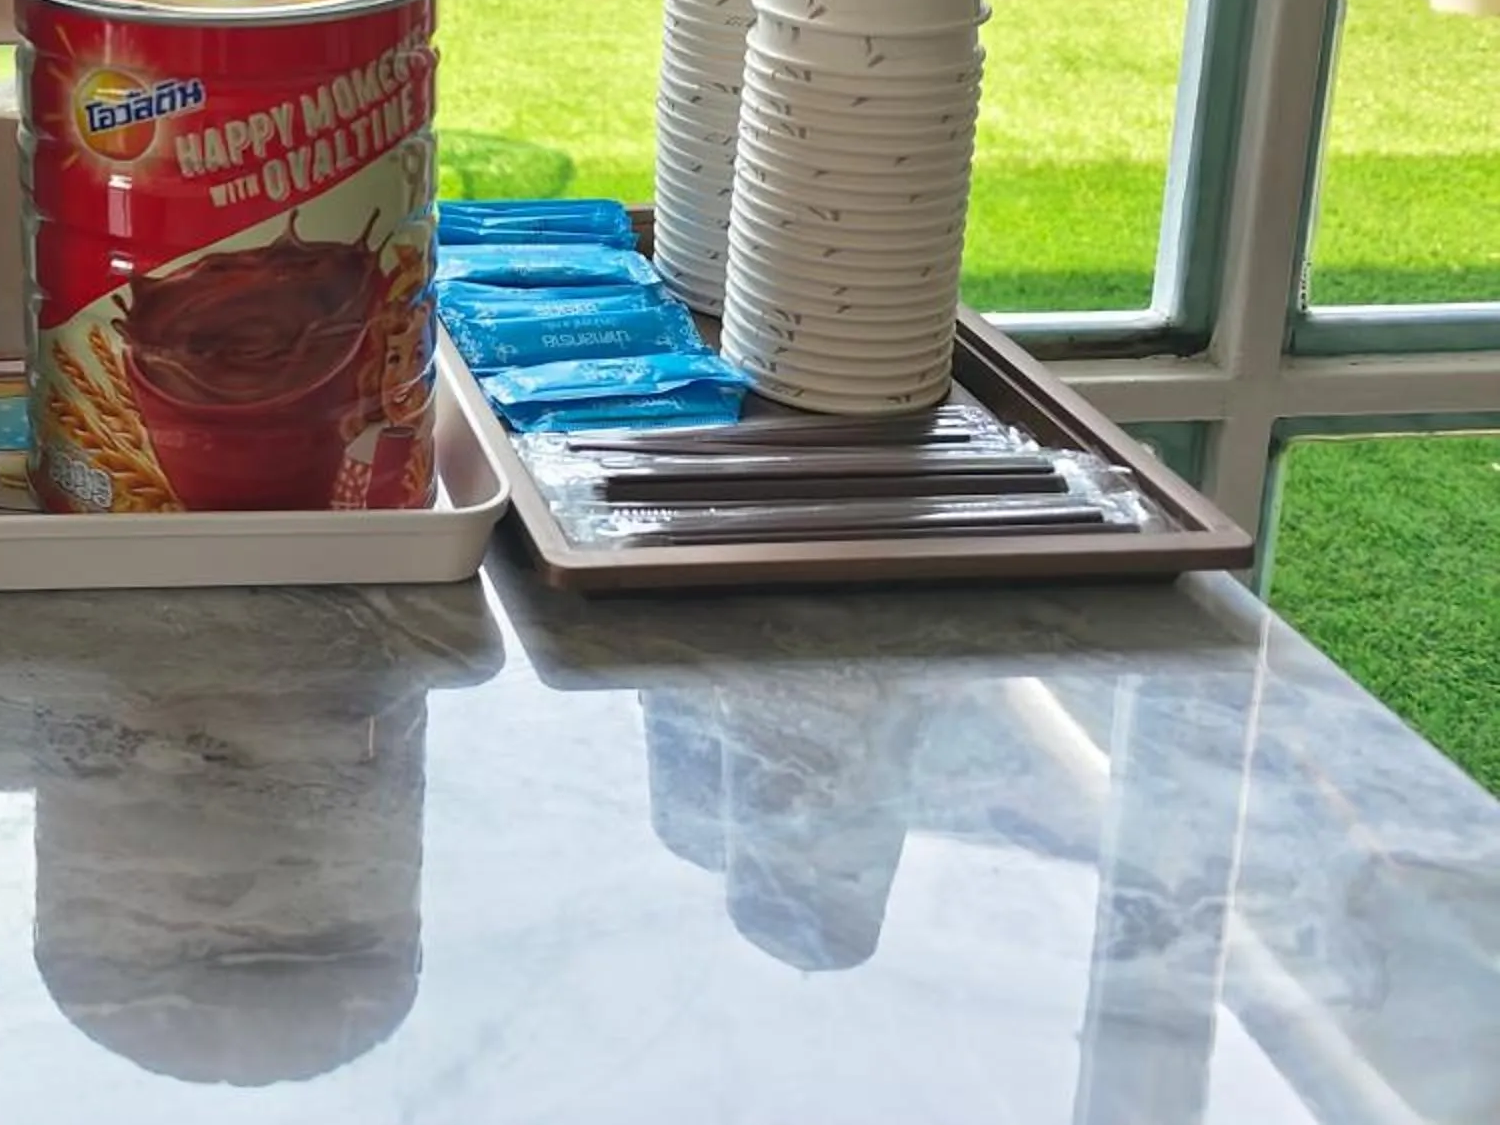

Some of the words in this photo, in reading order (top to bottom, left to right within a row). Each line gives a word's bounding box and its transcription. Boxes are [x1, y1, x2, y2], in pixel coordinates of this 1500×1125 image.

[85, 75, 206, 133] โอวัลติน
[174, 103, 294, 178] HAPPY
[209, 173, 260, 209] WITH
[262, 87, 416, 203] OVALTINE
